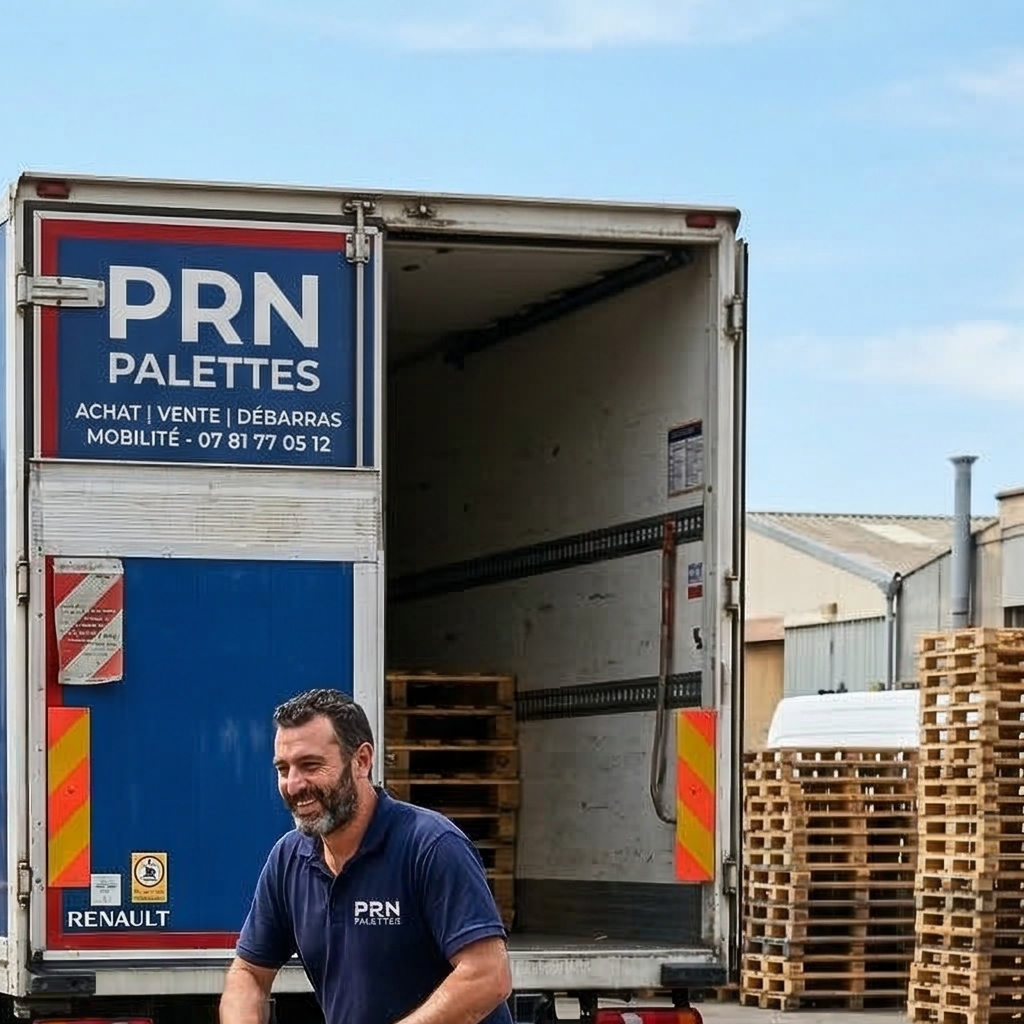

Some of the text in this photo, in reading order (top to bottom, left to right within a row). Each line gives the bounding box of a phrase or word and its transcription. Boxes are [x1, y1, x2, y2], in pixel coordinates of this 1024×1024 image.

[109, 265, 319, 348] PRN
[109, 352, 321, 392] PALETTES
[75, 403, 142, 420] ACHAT
[157, 406, 220, 424] VENTE
[237, 405, 342, 427] DÉBARRAS
[87, 427, 179, 446] MOBILITÉ
[198, 432, 223, 448] 07
[228, 432, 247, 449] 81
[253, 434, 277, 450] 77
[282, 435, 306, 451] 05
[311, 436, 331, 452] 12
[68, 910, 170, 927] RENAULT
[354, 901, 400, 917] PRN
